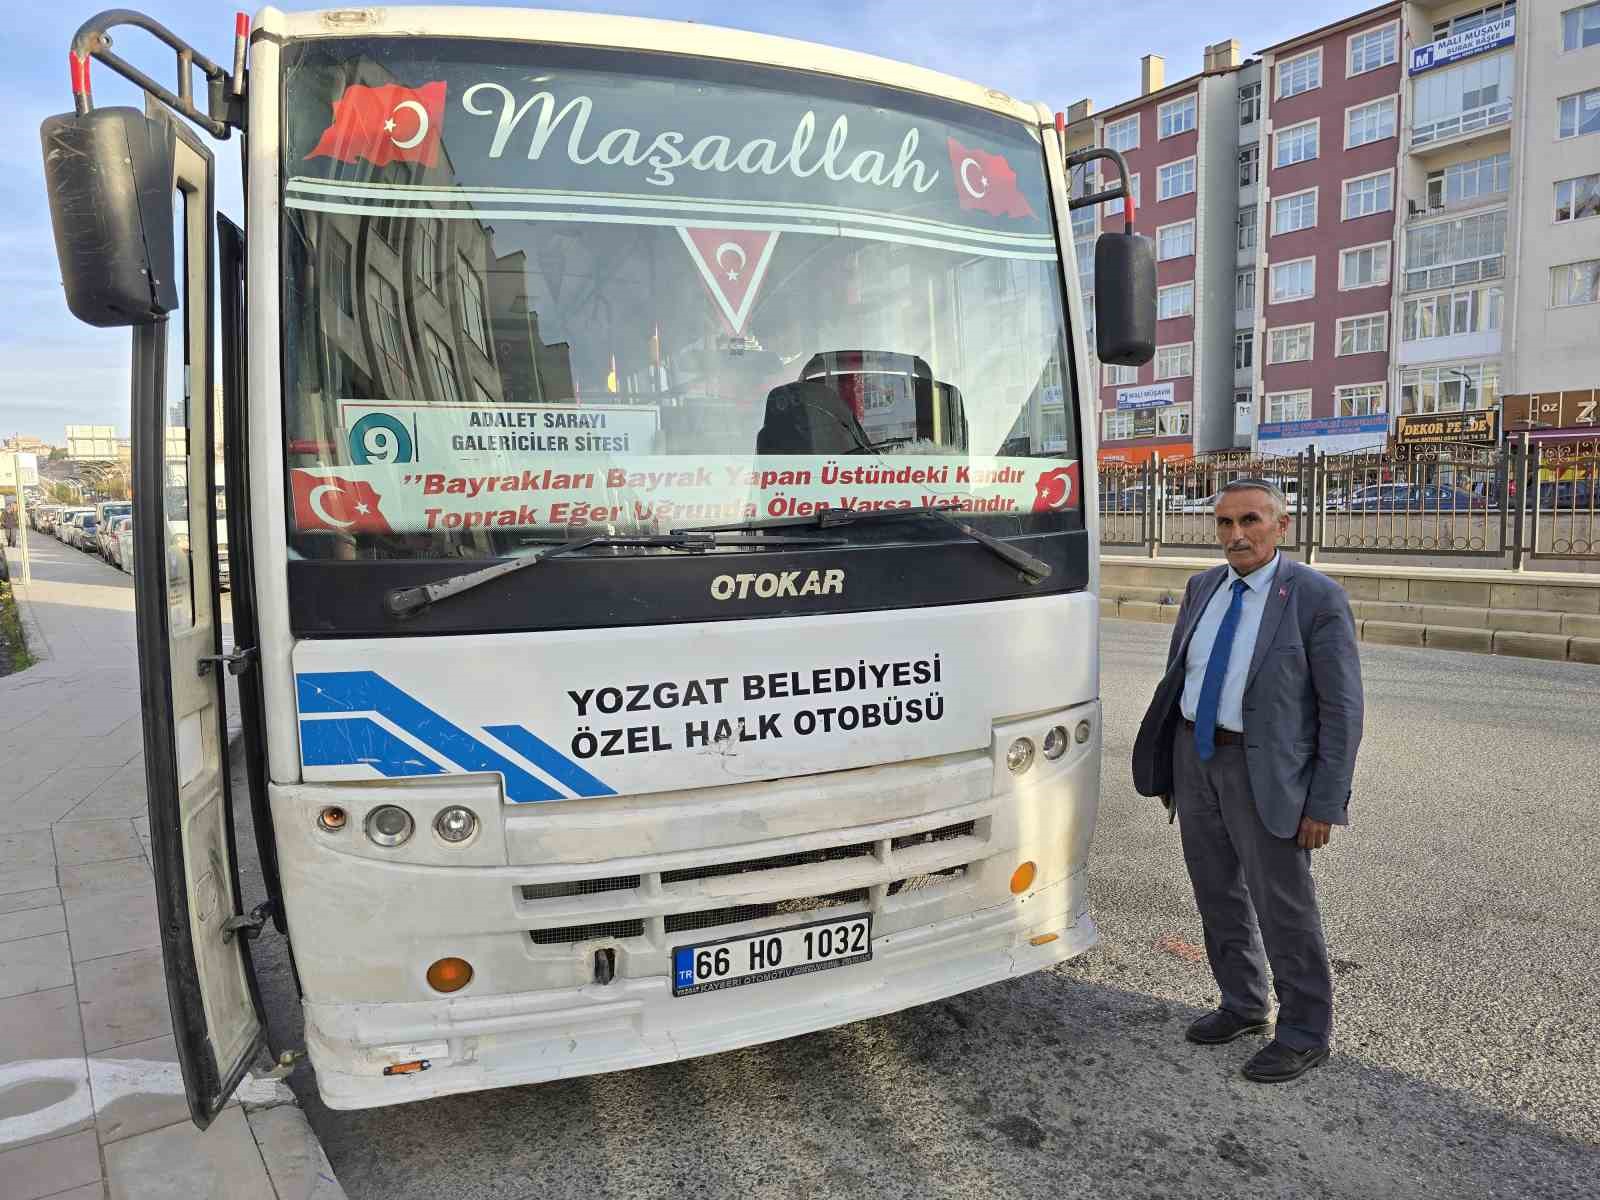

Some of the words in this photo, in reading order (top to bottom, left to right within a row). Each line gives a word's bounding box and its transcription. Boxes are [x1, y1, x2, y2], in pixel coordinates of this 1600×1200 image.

[462, 82, 939, 192] Maşaallah
[469, 411, 539, 429] ADALET
[543, 412, 606, 429] SARAYI
[1404, 422, 1444, 436] DEKOR
[1446, 420, 1487, 433] PEDE
[363, 426, 398, 465] 9
[451, 431, 569, 451] GALERİCİLER
[574, 432, 629, 451] SİTESİ
[607, 467, 712, 494] Bayrak
[726, 465, 811, 489] Yapan
[820, 461, 948, 486] Üstündeki
[424, 504, 539, 530] Toprak
[549, 501, 623, 527] Eğer
[767, 492, 830, 517] Ölen
[841, 495, 912, 512] Varsa
[710, 569, 847, 600] OTOKAR
[567, 676, 729, 718] YOZGAT
[743, 652, 942, 702] BELEDİYESİ
[570, 725, 673, 760] ÖZEL
[685, 712, 783, 748] HALK
[793, 692, 944, 736] OTOBÜSÜ
[679, 970, 693, 980] TR
[696, 947, 731, 980] 66
[803, 923, 866, 961] 1032
